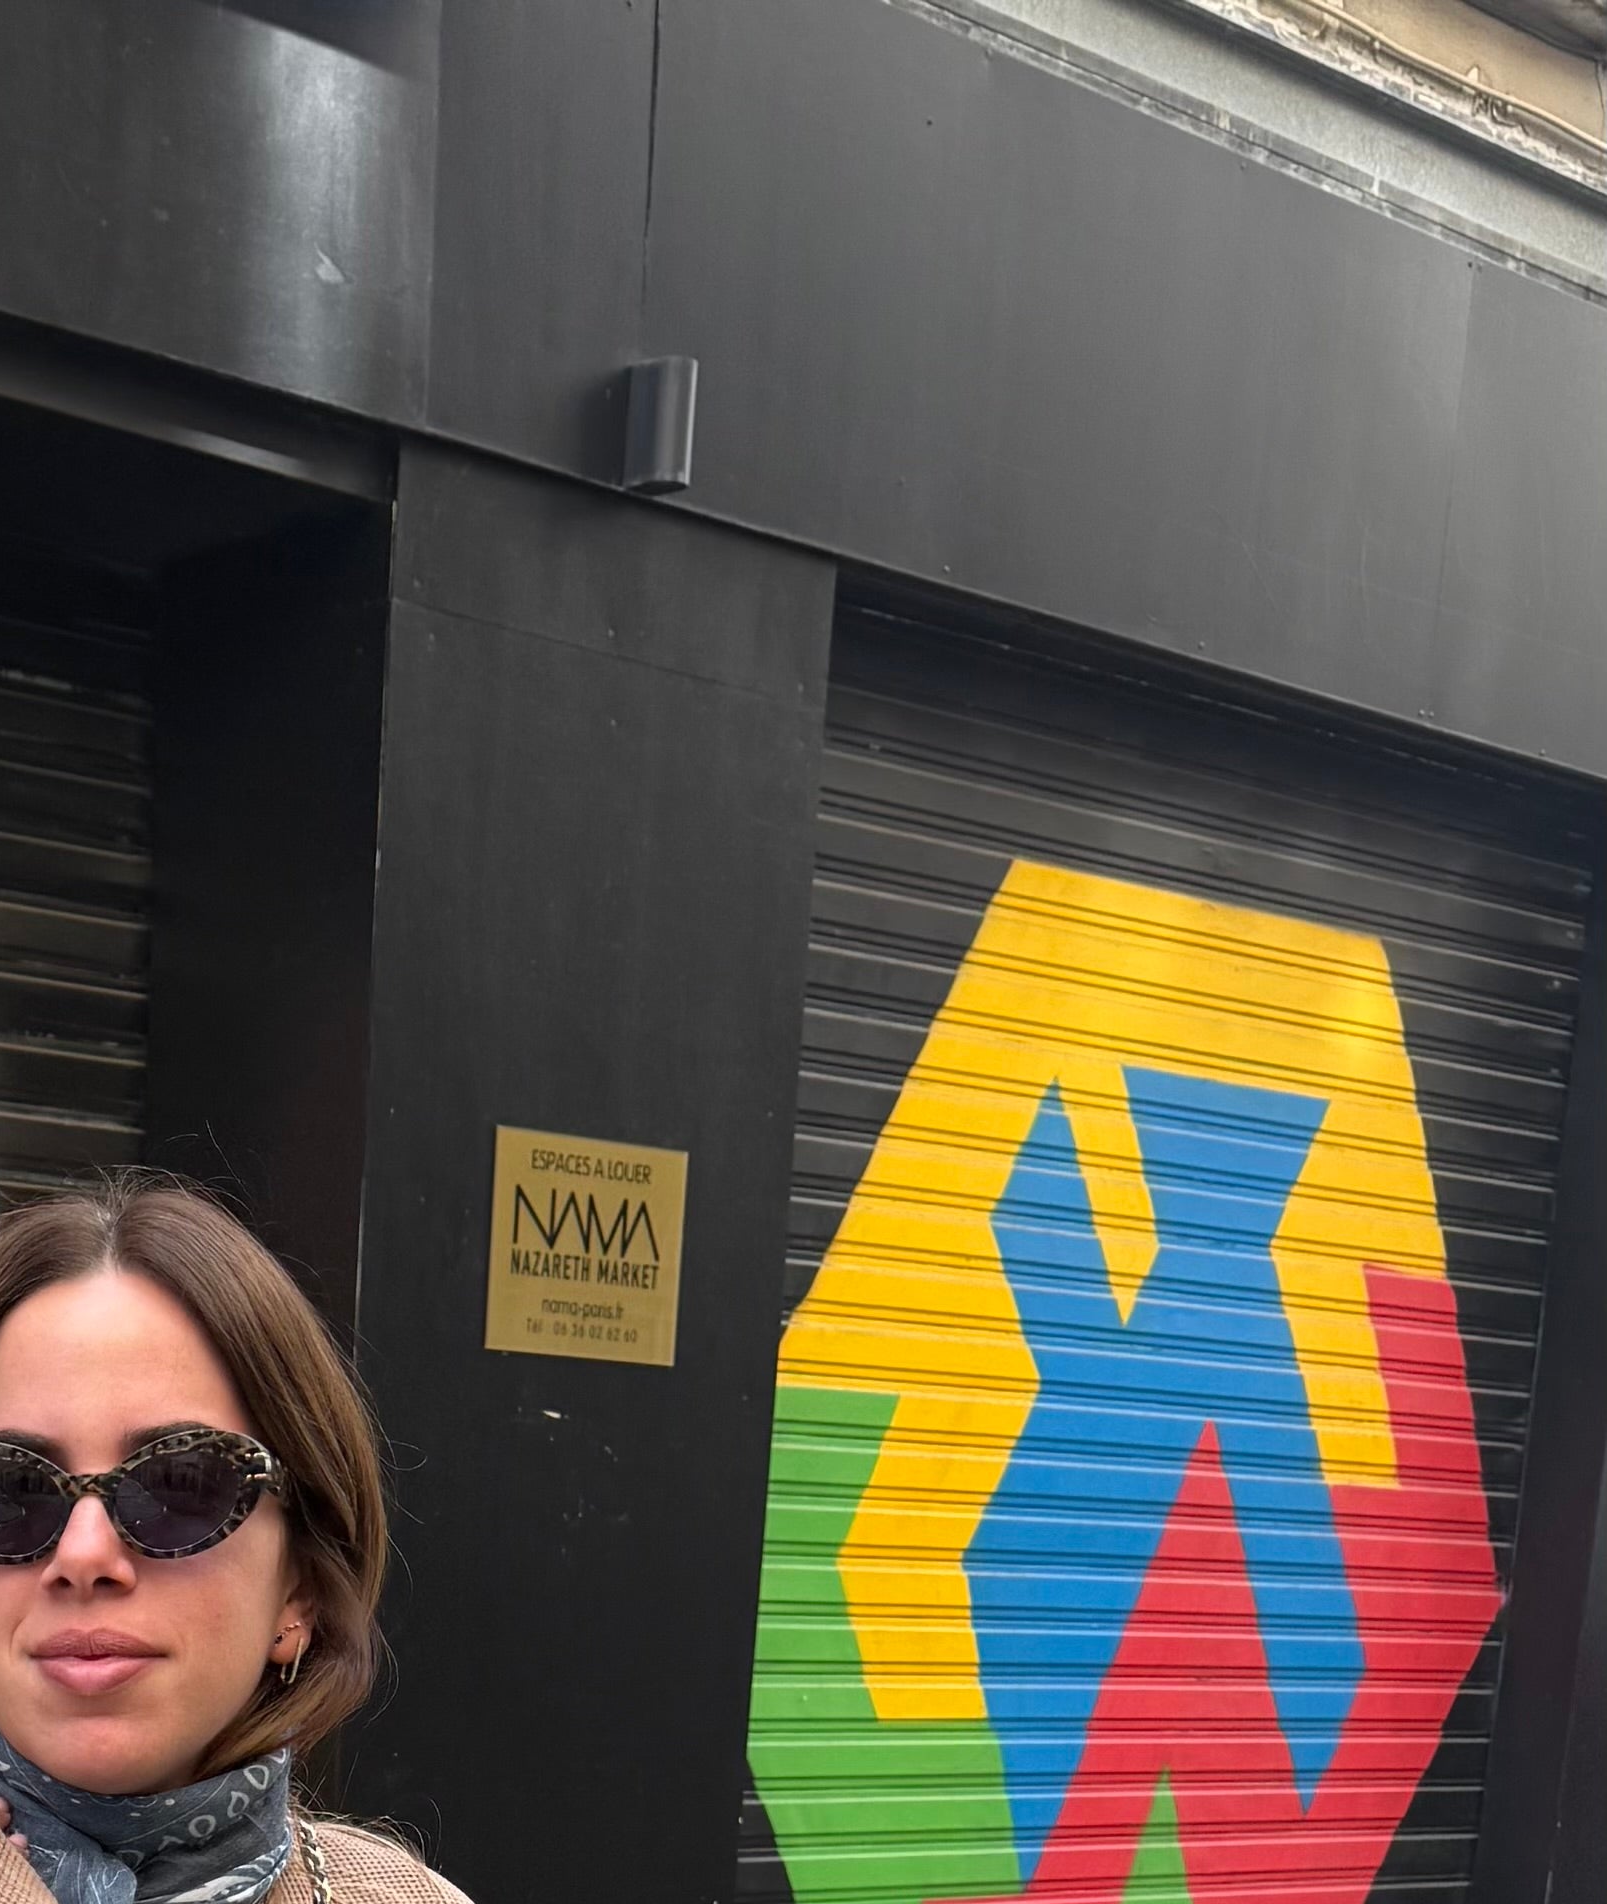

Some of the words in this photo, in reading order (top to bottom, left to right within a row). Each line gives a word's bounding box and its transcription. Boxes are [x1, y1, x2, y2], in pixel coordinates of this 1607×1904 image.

[531, 1149, 590, 1176] ESPACES
[607, 1160, 652, 1184] LOUER
[513, 1184, 660, 1263] NAMA
[510, 1248, 591, 1282] NAZARETH
[597, 1259, 659, 1290] MARKET
